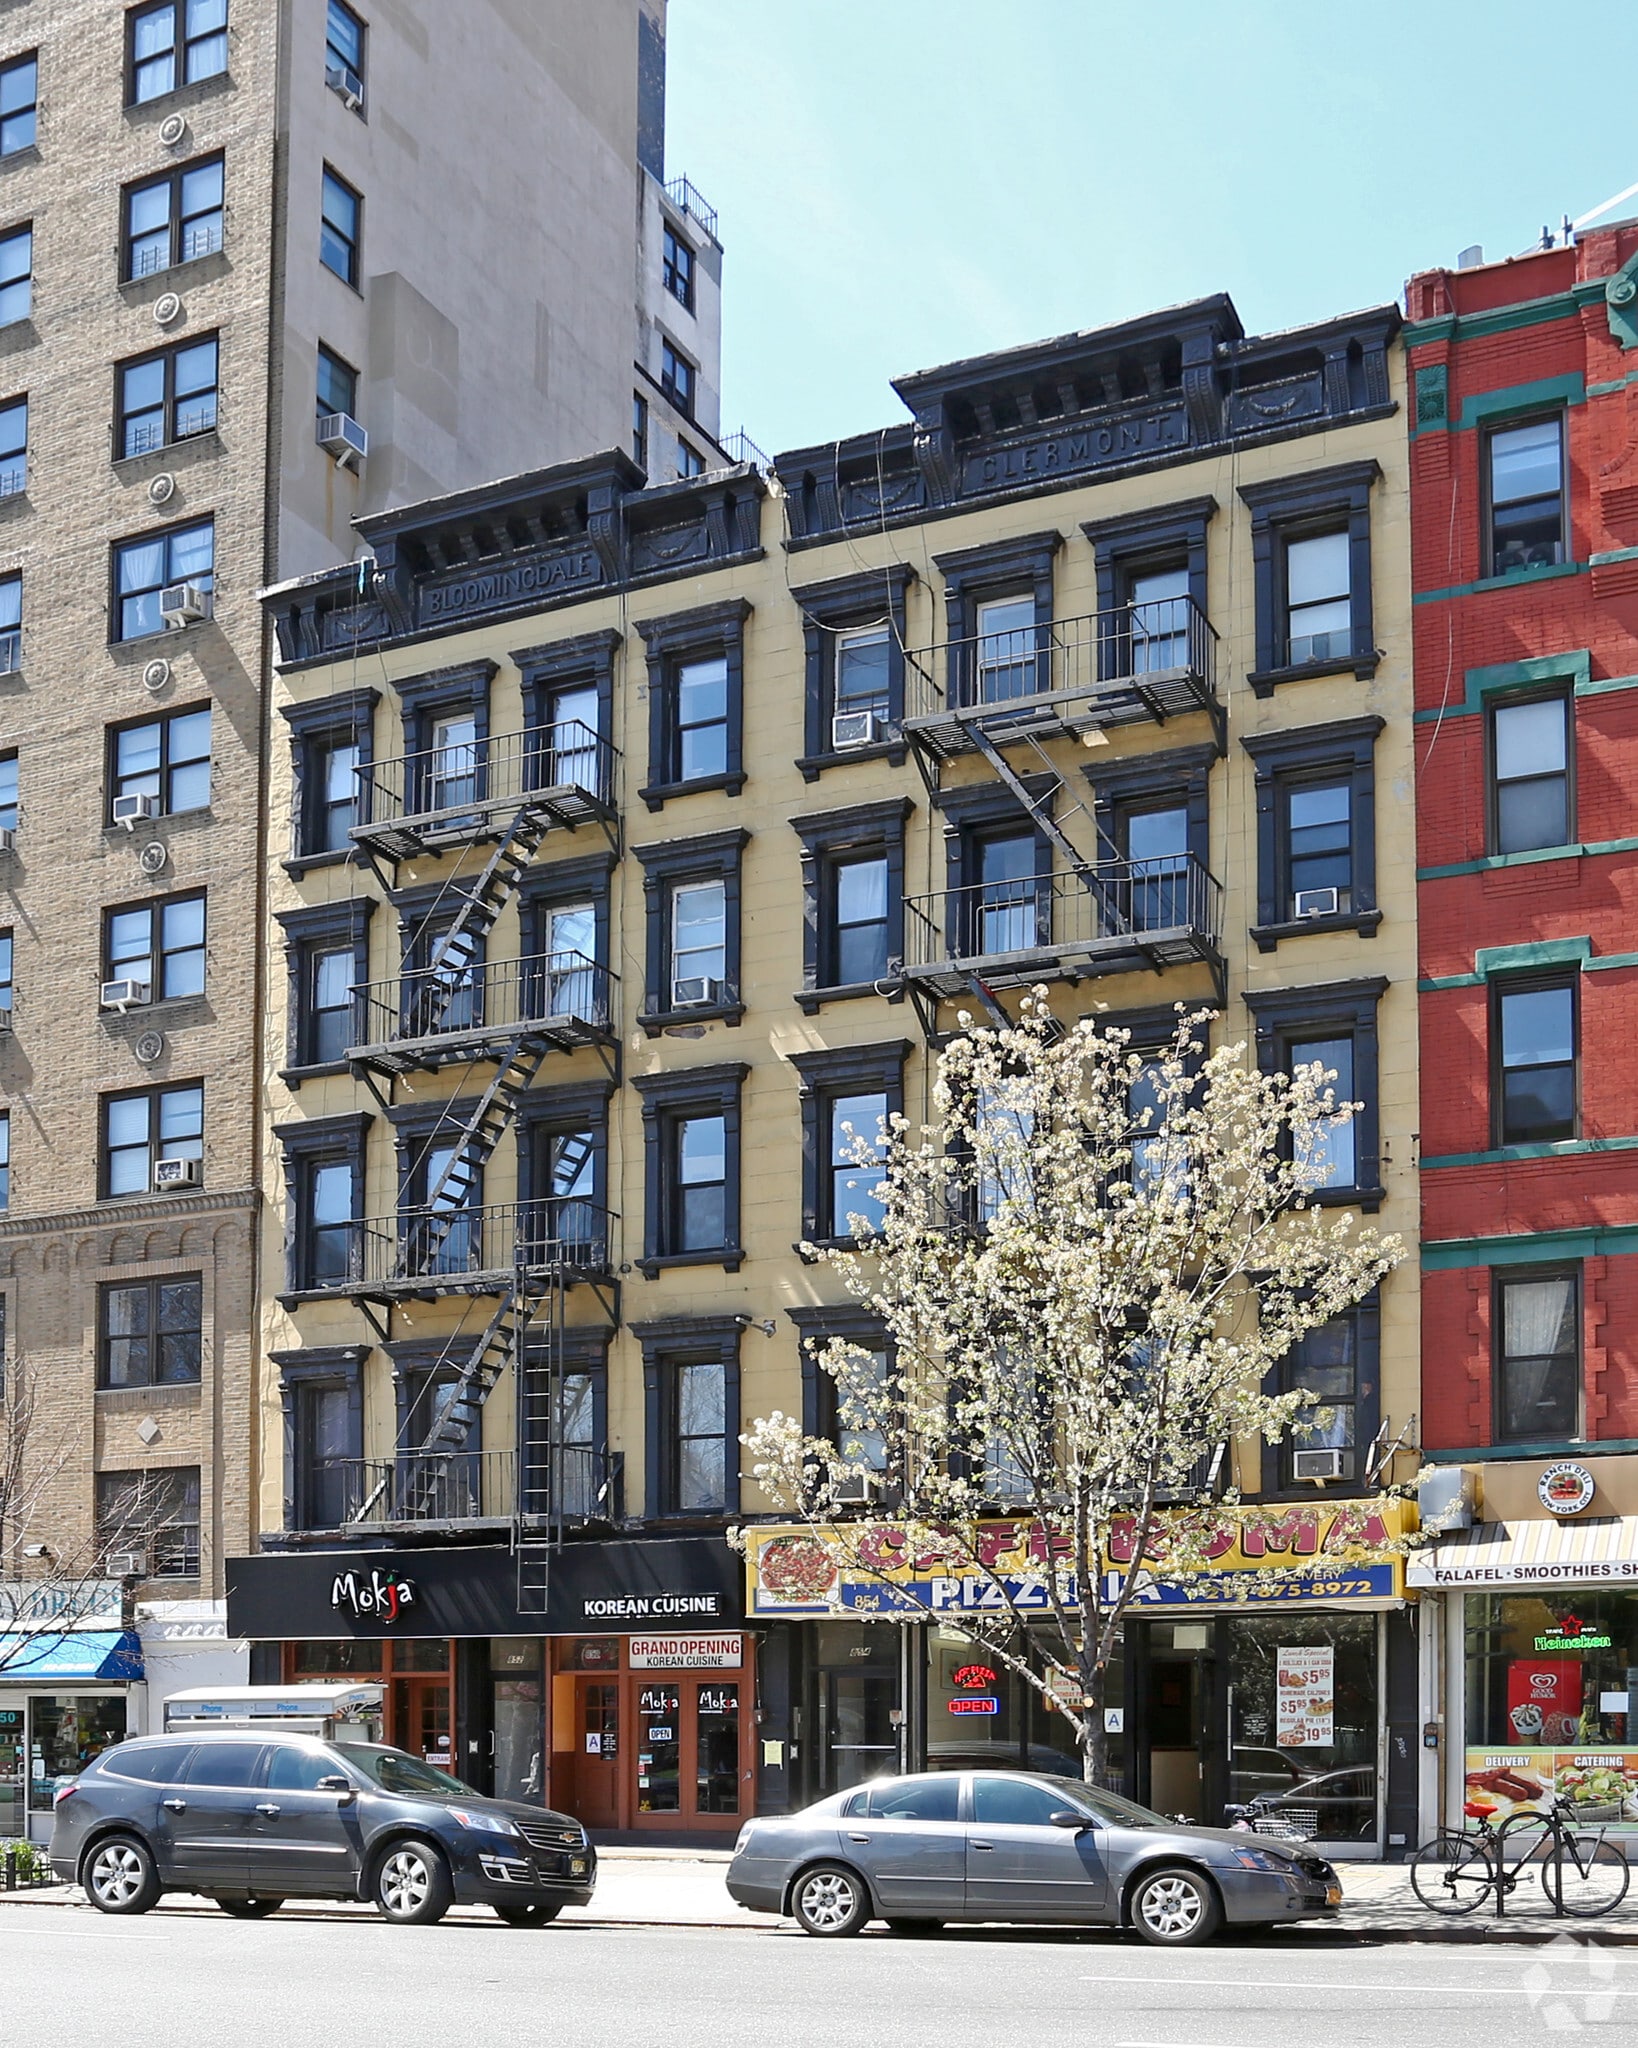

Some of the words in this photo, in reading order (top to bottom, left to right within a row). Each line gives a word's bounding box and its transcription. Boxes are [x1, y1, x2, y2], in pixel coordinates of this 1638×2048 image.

[1540, 1464, 1571, 1486] RANCH
[1574, 1466, 1591, 1484] DELI
[1541, 1494, 1555, 1508] NEW
[1556, 1503, 1579, 1513] YORK
[1579, 1491, 1591, 1506] CITY
[1435, 1569, 1503, 1581] FALAFEL
[1514, 1565, 1611, 1578] SMOOTHIES
[331, 1570, 413, 1619] Mokja
[584, 1600, 649, 1615] KOREAN
[652, 1597, 716, 1613] CUISINE
[632, 1642, 678, 1655] GRAND
[680, 1640, 740, 1654] OPENING
[1534, 1635, 1612, 1650] Heineken
[647, 1657, 684, 1666] KOREAN
[686, 1656, 724, 1665] CUISINE
[949, 1701, 993, 1713] OPEN
[1109, 1714, 1119, 1726] A
[651, 1730, 670, 1738] OPEN
[589, 1736, 598, 1747] A
[1485, 1757, 1529, 1766] DELIVERY
[1575, 1757, 1623, 1766] CATERING
